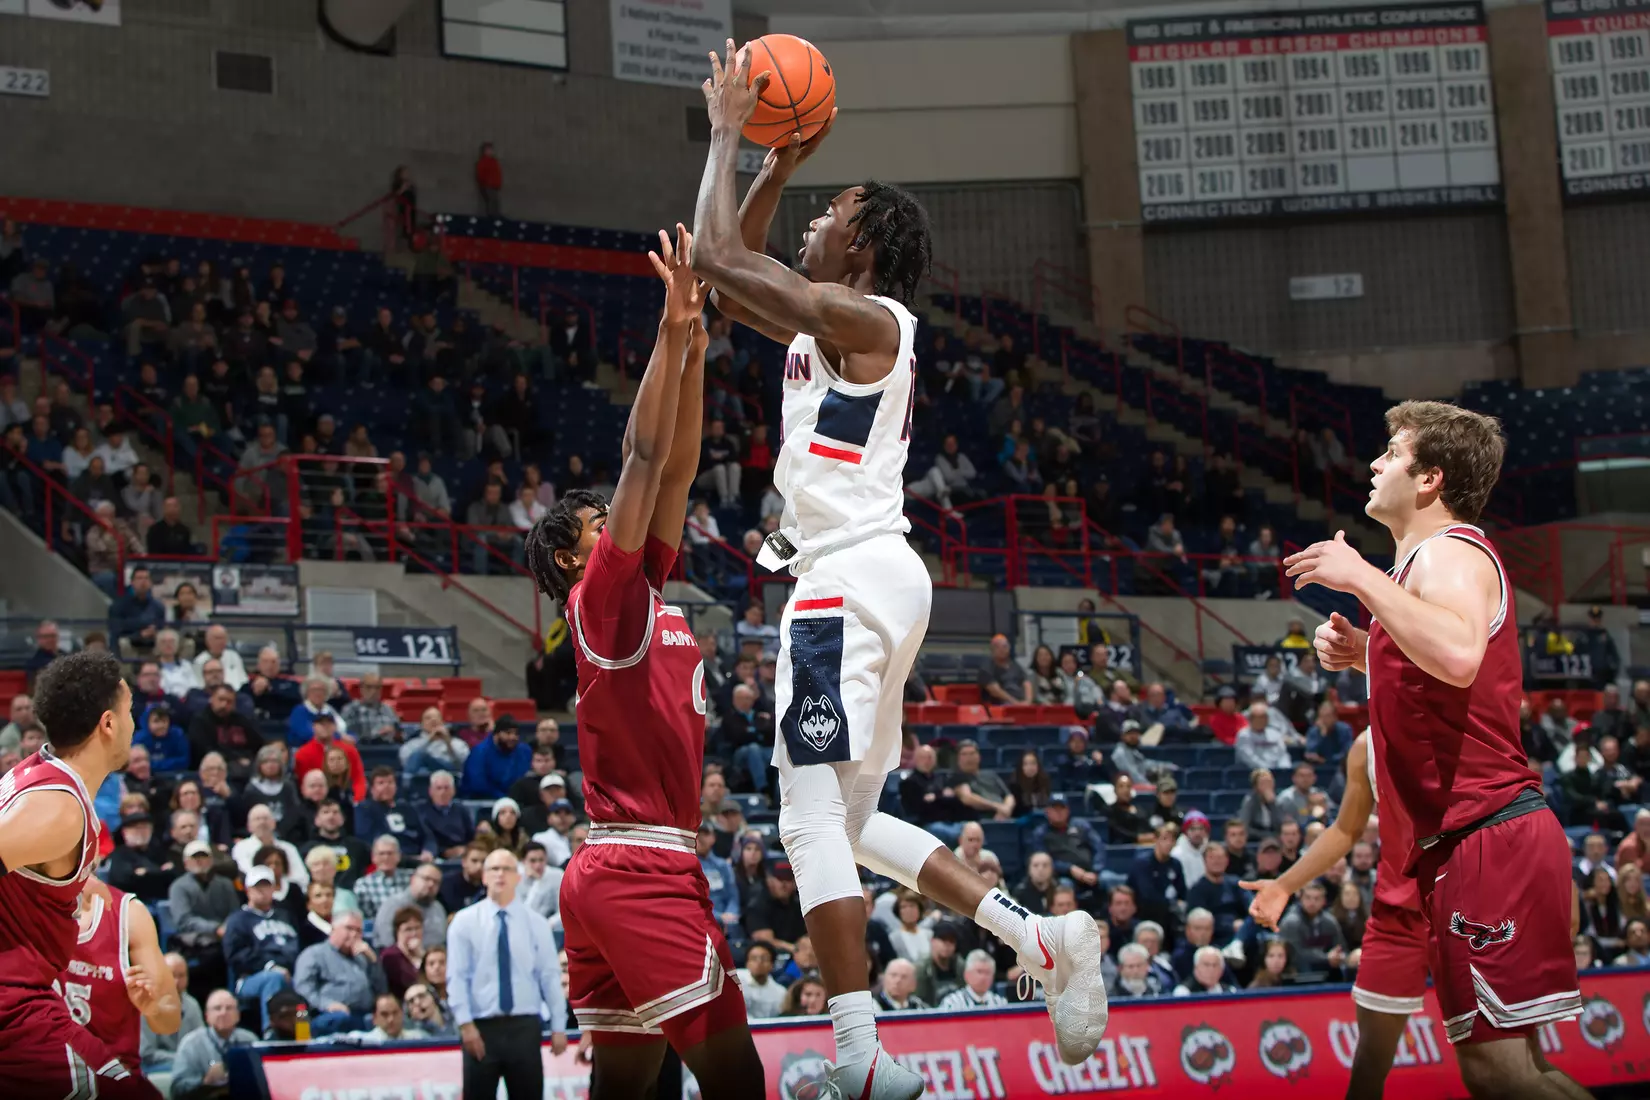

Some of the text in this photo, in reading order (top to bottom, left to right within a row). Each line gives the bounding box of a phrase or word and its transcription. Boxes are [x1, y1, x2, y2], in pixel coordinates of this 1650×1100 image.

[1164, 21, 1202, 37] EAST
[1208, 19, 1221, 34] &
[1224, 17, 1302, 33] AMERICAN
[1304, 11, 1378, 29] ATHLETIC
[1379, 6, 1477, 25] CONFERENCE
[1137, 27, 1479, 60] REGULAR SEASON CHAMPIONS
[1609, 36, 1643, 60] 1991
[1293, 57, 1329, 79] 1994
[1344, 53, 1380, 77] 1995
[1446, 48, 1480, 72] 1997
[6, 72, 48, 91] 222
[1296, 92, 1333, 117] 2001
[1345, 90, 1384, 114] 2002
[1396, 87, 1436, 111] 2003
[1447, 84, 1488, 108] 2004
[1142, 137, 1182, 161] 2007
[1299, 129, 1336, 152] 2010
[1350, 125, 1387, 150] 2011
[1401, 121, 1438, 147] 2014
[1451, 119, 1489, 144] 2015
[1569, 146, 1605, 172] 2017
[1146, 172, 1183, 197] 2016
[1197, 170, 1234, 194] 2017
[1143, 199, 1273, 220] CONNECTICUT
[1376, 186, 1496, 208] BASKETBALL
[356, 634, 450, 660] SEC 121
[1561, 653, 1592, 676] 123
